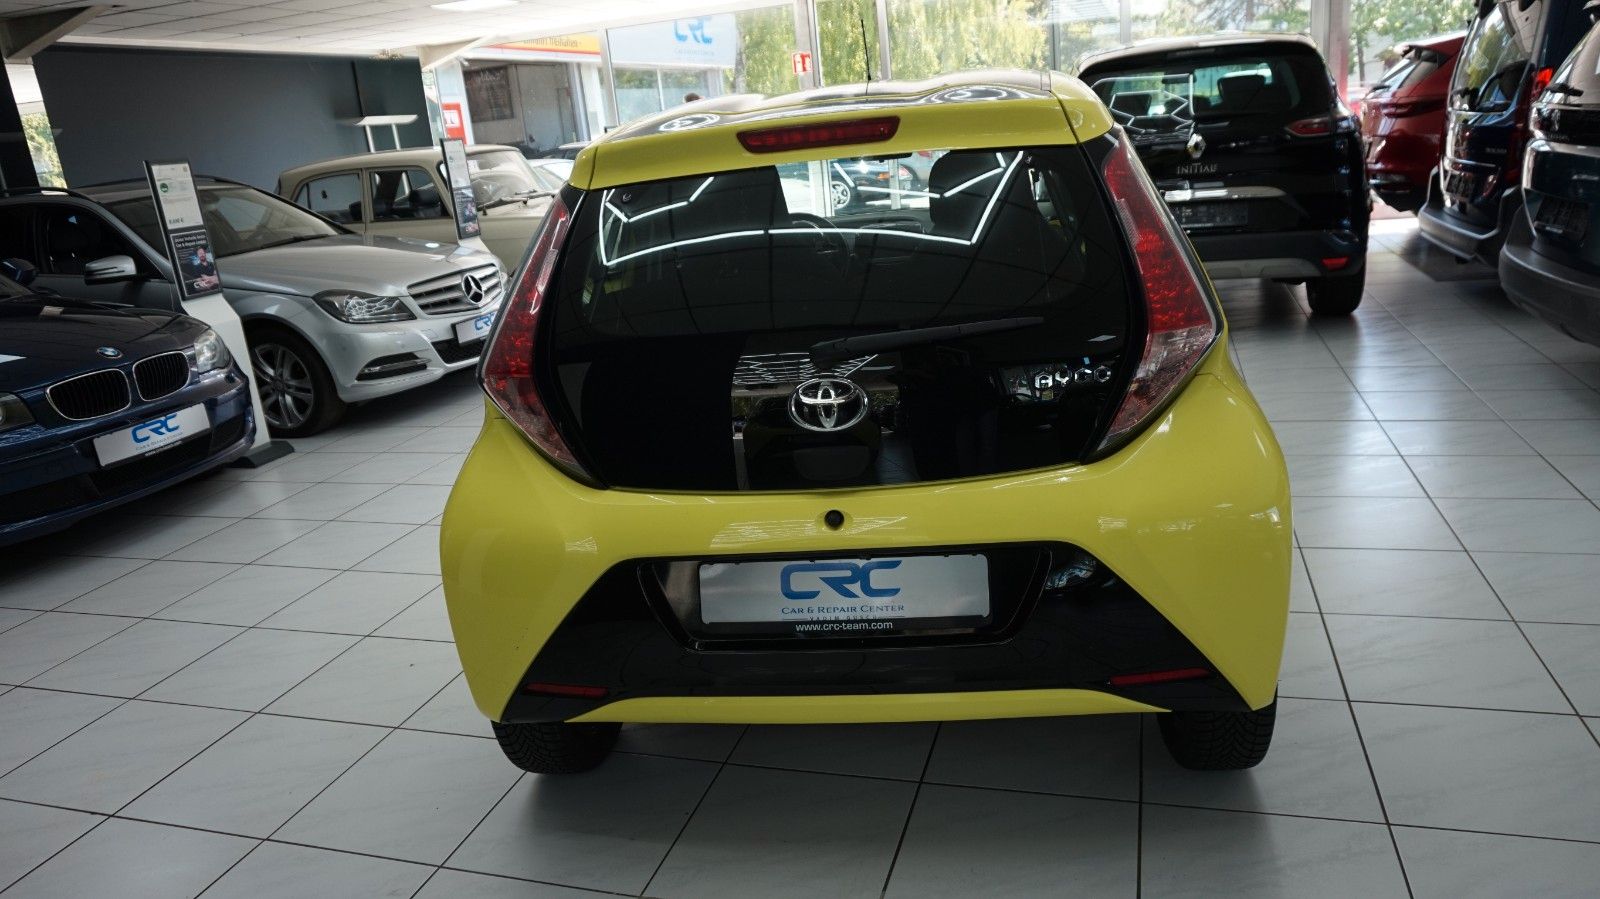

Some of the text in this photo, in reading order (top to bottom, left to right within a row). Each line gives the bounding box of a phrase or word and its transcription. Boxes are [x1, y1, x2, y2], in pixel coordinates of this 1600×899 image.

[131, 412, 180, 444] CRC
[780, 559, 903, 600] CRC
[795, 621, 894, 632] www.crc-team.com
